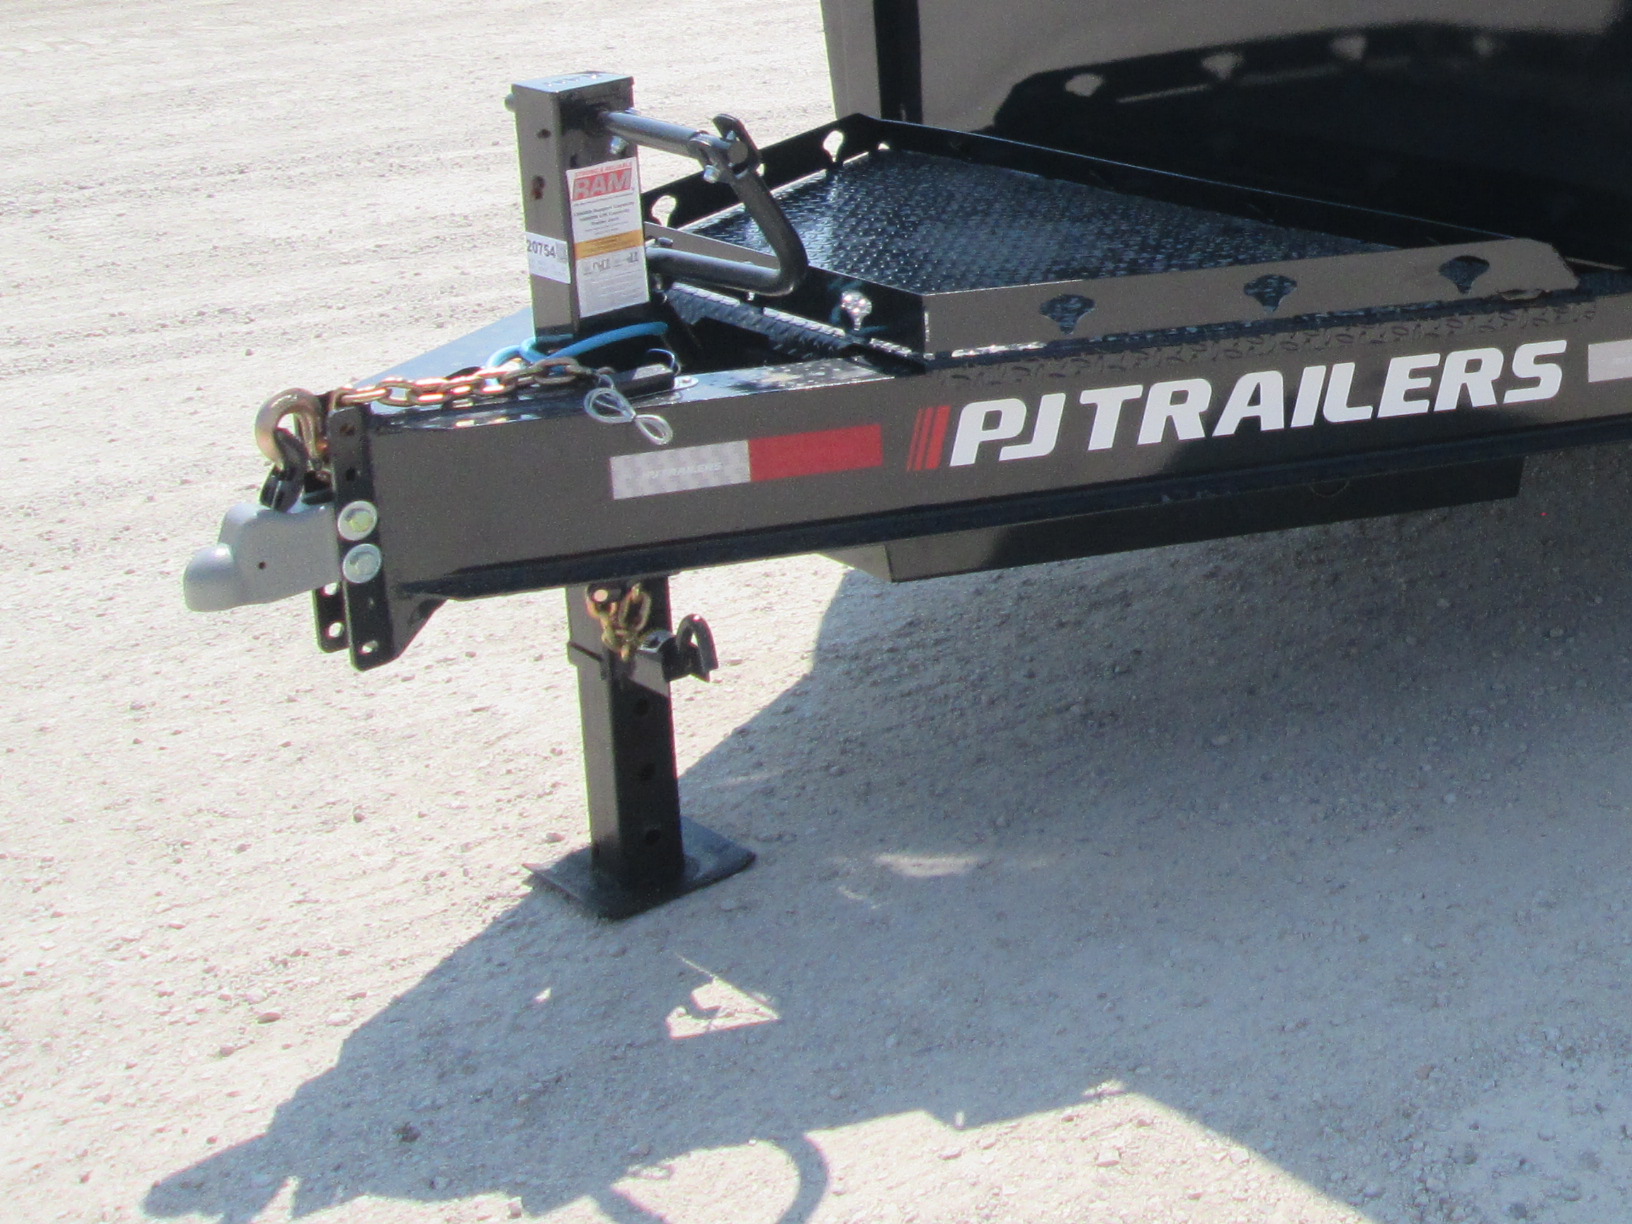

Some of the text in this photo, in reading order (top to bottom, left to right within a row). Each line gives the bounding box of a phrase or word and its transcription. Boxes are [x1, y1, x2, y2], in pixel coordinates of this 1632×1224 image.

[573, 170, 632, 201] RAM
[526, 239, 556, 258] 20754
[950, 339, 1567, 467] PJ TRAILERS
